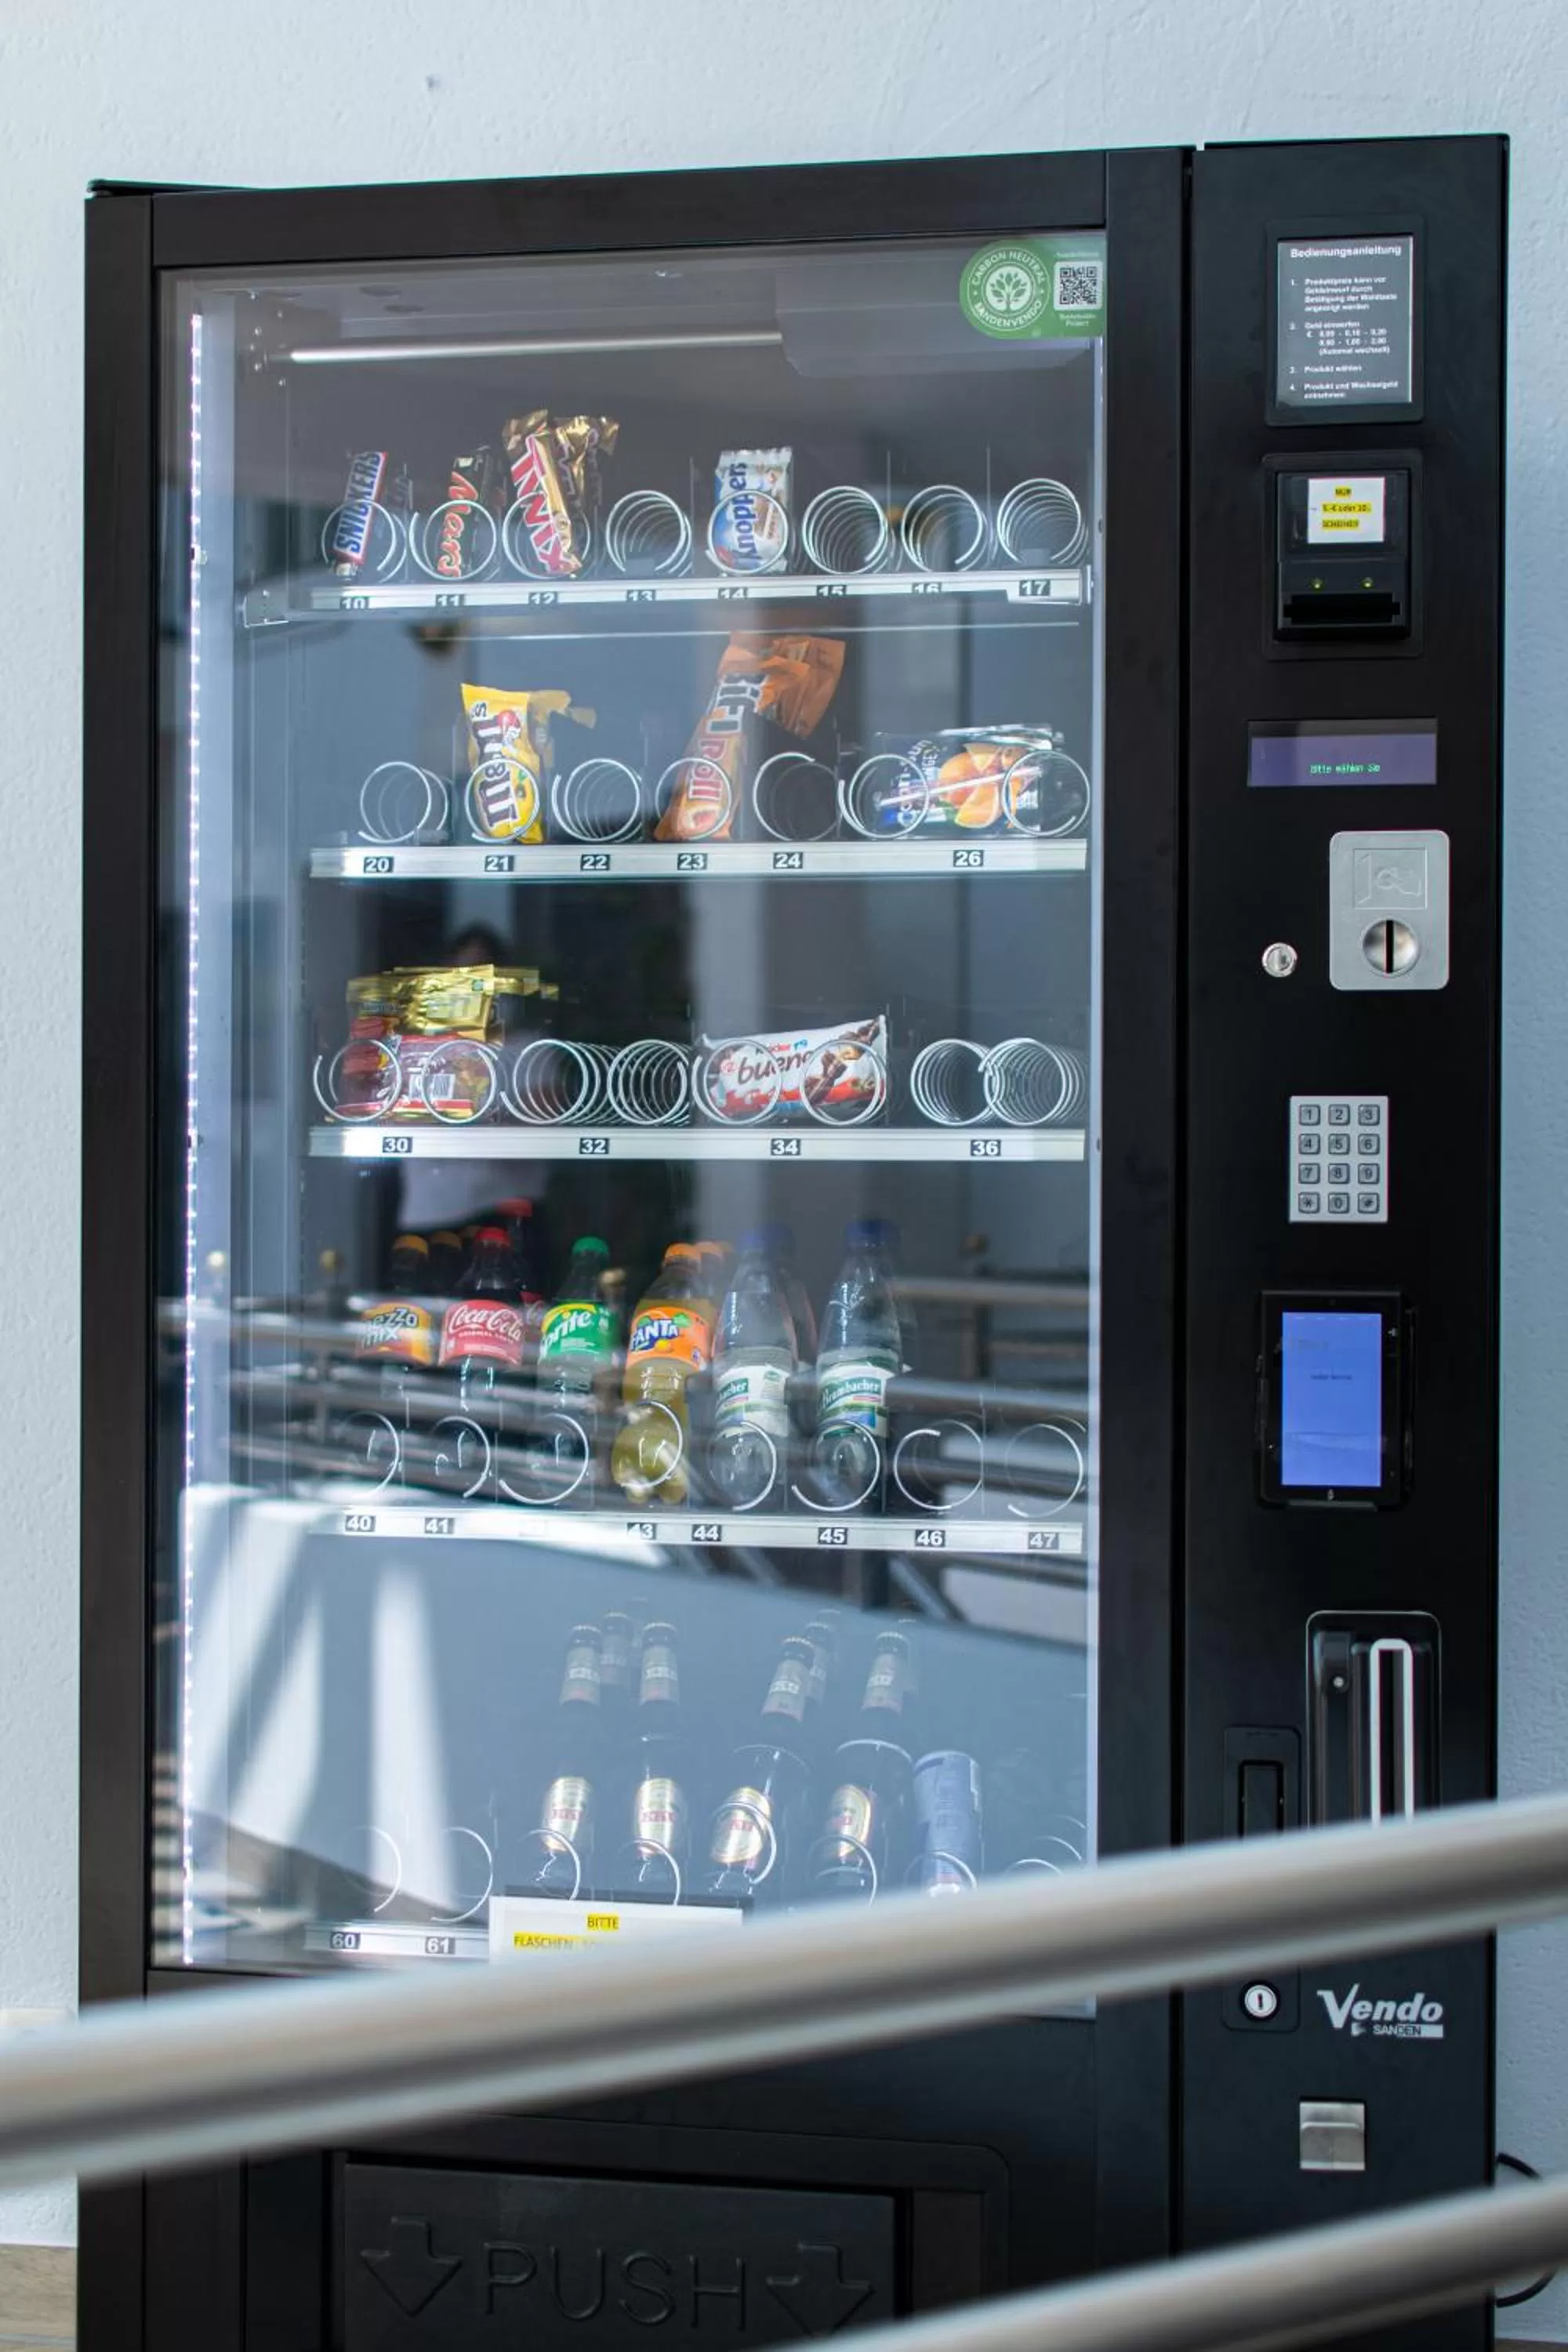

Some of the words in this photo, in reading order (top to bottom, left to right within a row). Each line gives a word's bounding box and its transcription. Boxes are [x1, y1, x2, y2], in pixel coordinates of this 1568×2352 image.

[1290, 245, 1402, 258] Bedienungsanleitung
[972, 251, 1007, 285] CARBON
[1009, 250, 1046, 283] NEUTRAL
[337, 452, 381, 554] SNICKERS
[511, 436, 580, 575] TWIX
[1021, 581, 1045, 596] 17
[365, 857, 390, 873] 20
[487, 856, 510, 871] 21
[583, 855, 607, 870] 22
[680, 854, 704, 869] 23
[775, 852, 801, 868] 24
[955, 851, 982, 866] 26
[1304, 1109, 1312, 1120] 1
[1335, 1109, 1343, 1120] 2
[1365, 1109, 1373, 1120] 3
[384, 1138, 408, 1152] 30
[581, 1139, 606, 1153] 32
[772, 1141, 799, 1155] 34
[973, 1141, 998, 1155] 36
[1304, 1139, 1312, 1149] 4
[1335, 1139, 1343, 1149] 5
[1365, 1139, 1372, 1149] 6
[1305, 1167, 1312, 1178] 7
[1334, 1197, 1342, 1208] 0
[449, 1305, 524, 1342] Coca-Cola
[630, 1319, 679, 1350] FANTA
[346, 1515, 372, 1531] 40
[425, 1519, 449, 1533] 41
[628, 1523, 654, 1539] 43
[692, 1525, 720, 1541] 44
[820, 1528, 846, 1543] 45
[916, 1530, 943, 1545] 46
[1029, 1533, 1055, 1548] 47
[587, 1916, 619, 1930] BITTE
[331, 1932, 358, 1949] 60
[427, 1937, 450, 1953] 61
[1316, 1983, 1443, 2029] Vendo
[1372, 2024, 1421, 2037] SANDEN
[484, 2240, 746, 2332] PUSH
